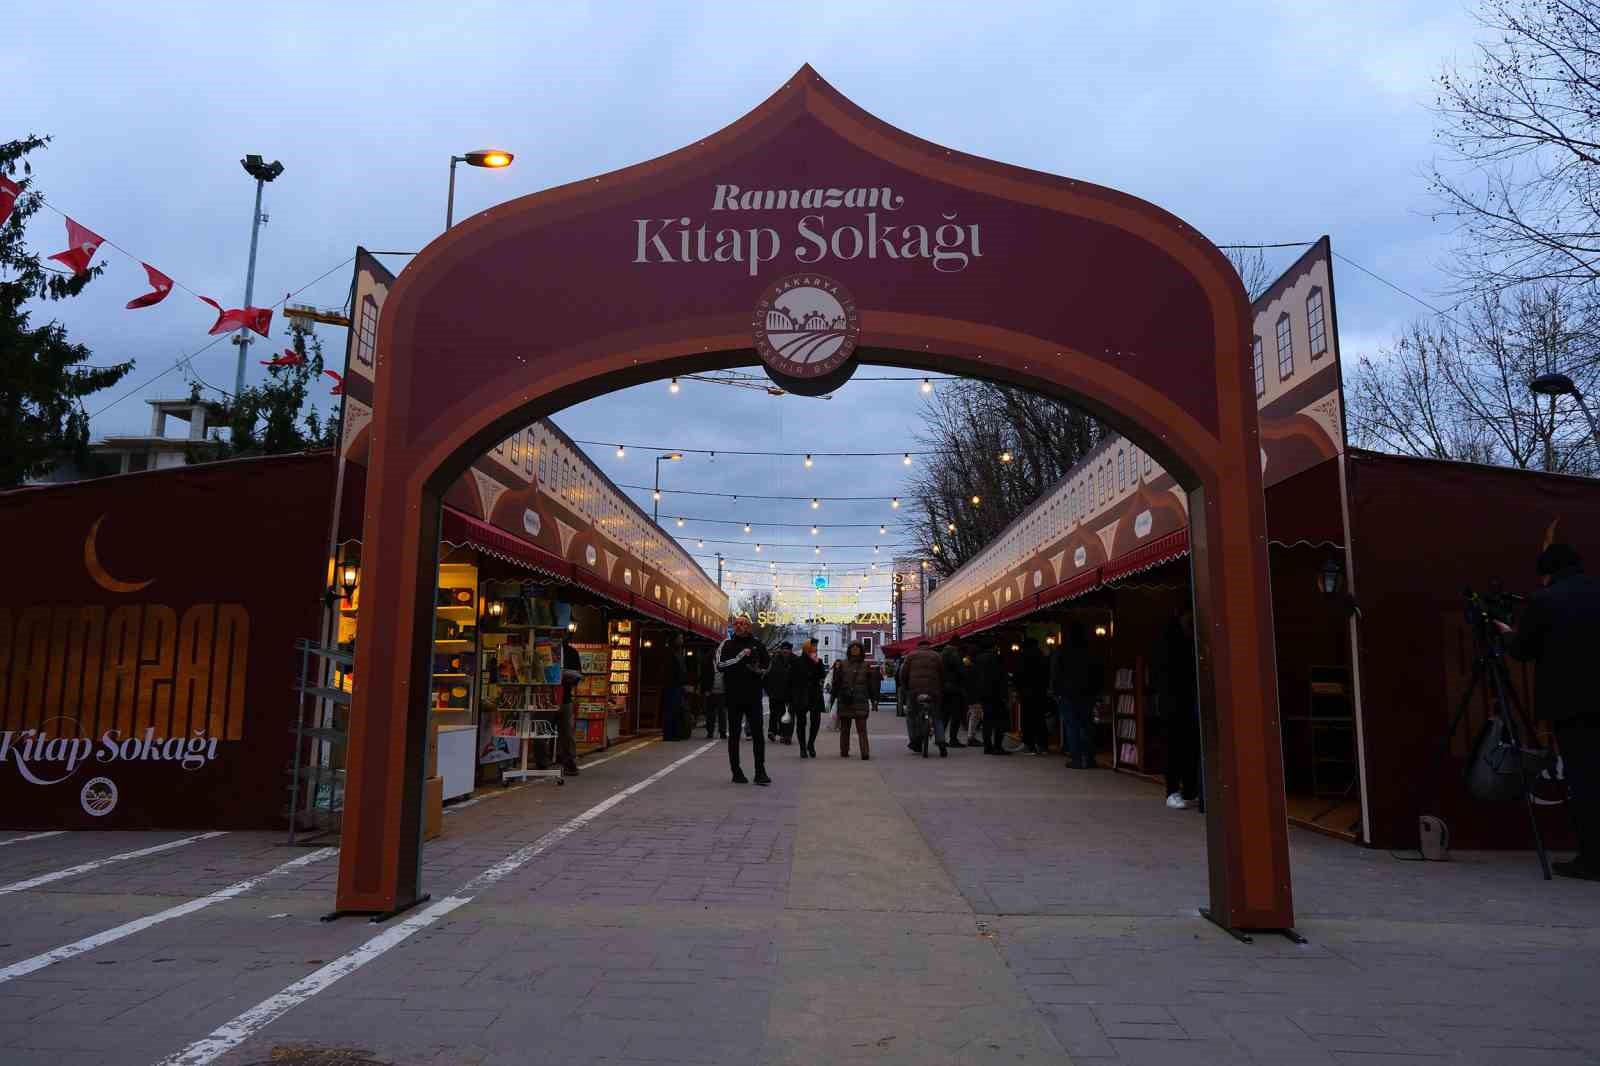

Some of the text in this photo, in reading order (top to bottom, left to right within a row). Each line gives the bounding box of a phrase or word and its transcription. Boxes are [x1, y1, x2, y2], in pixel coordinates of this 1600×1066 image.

[712, 183, 905, 211] Ramazan
[632, 210, 982, 276] Kitap Sokağı
[0, 727, 218, 785] Kitap Sokağı
